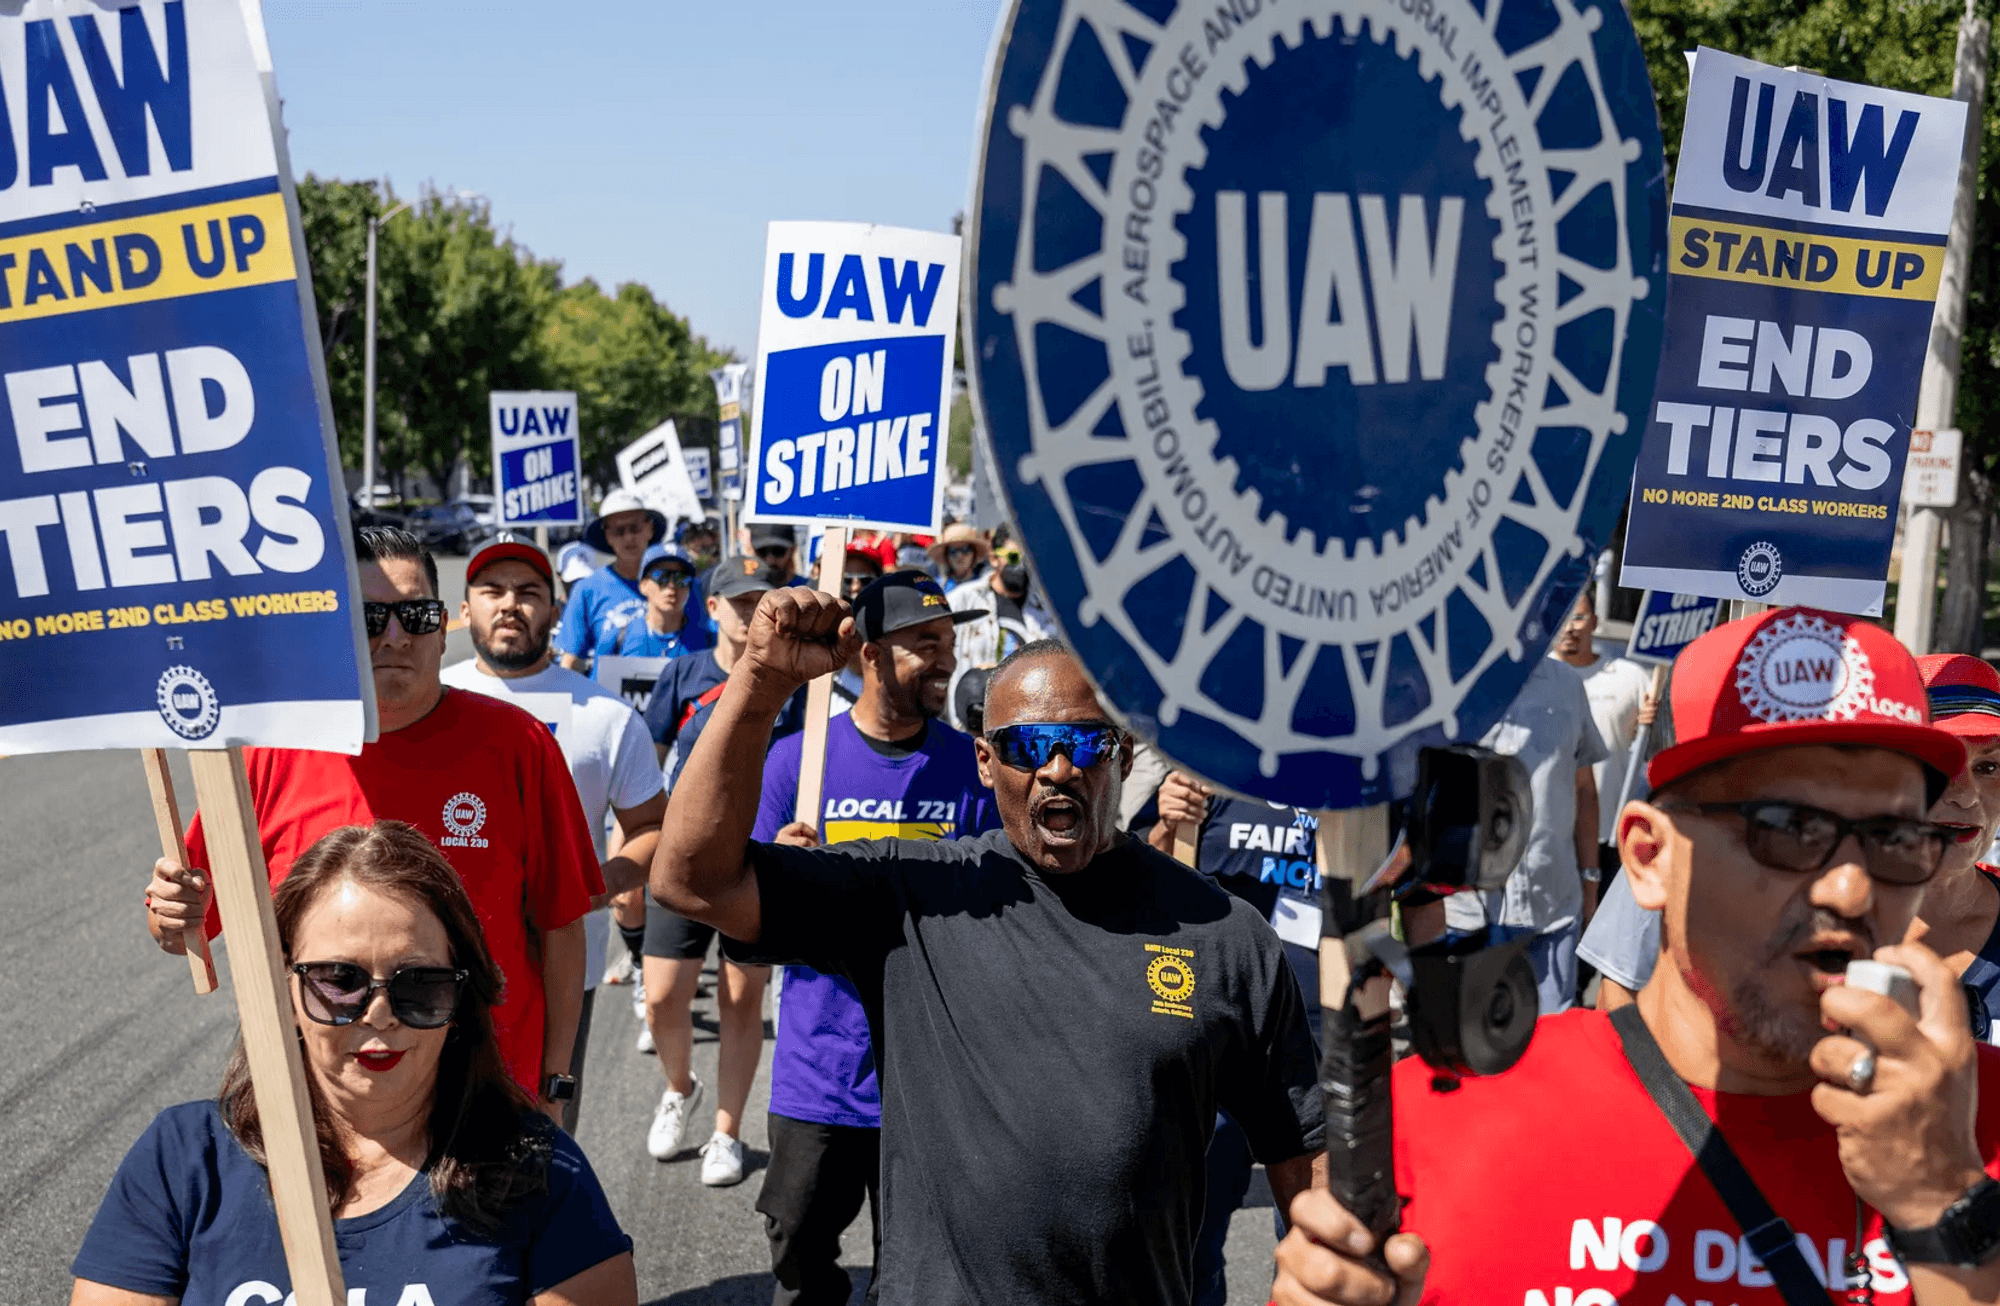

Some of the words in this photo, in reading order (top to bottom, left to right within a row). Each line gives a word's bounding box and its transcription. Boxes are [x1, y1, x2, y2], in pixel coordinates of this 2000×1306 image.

[0, 0, 193, 191] AW
[1123, 41, 1207, 306] AEROSPACE
[1460, 51, 1538, 270] IMPLEMENT
[1722, 75, 1921, 218] UAW
[181, 214, 266, 279] UP
[1679, 227, 1838, 283] STAND
[1855, 248, 1925, 290] UP
[776, 252, 946, 328] UAW
[1216, 190, 1465, 391] UAW
[819, 349, 886, 422] ON
[1485, 283, 1538, 475] WORKERS
[1697, 314, 1873, 400] END
[4, 346, 254, 474] END
[499, 407, 569, 436] UAW
[523, 447, 553, 482] ON
[763, 412, 932, 505] STRIKE
[1655, 401, 1896, 491] TIERS
[505, 471, 575, 519] STRIKE
[1466, 478, 1492, 530] OF
[1642, 488, 1668, 503] NO
[1672, 490, 1718, 508] MORE
[1721, 493, 1754, 510] 2ND
[1757, 496, 1808, 514] CLASS
[1812, 500, 1887, 519] WORKERS
[0, 466, 325, 598] TIERS
[1252, 565, 1358, 622] UNITED
[1368, 519, 1465, 617] AMERICA
[1750, 561, 1769, 574] UAW
[0, 618, 31, 641] NO
[36, 610, 105, 636] MORE
[108, 605, 150, 628] 2ND
[154, 599, 228, 625] CLASS
[230, 590, 339, 618] WORKERS
[1639, 606, 1714, 650] STRIKE
[1775, 658, 1834, 686] UAW
[455, 808, 474, 819] UAW
[825, 798, 908, 820] LOCAL
[917, 801, 956, 820] 721
[441, 836, 469, 847] LOCAL
[470, 838, 489, 848] 230
[1229, 823, 1309, 856] FAIR
[1160, 971, 1181, 984] UAW
[1569, 1216, 1669, 1272] NO
